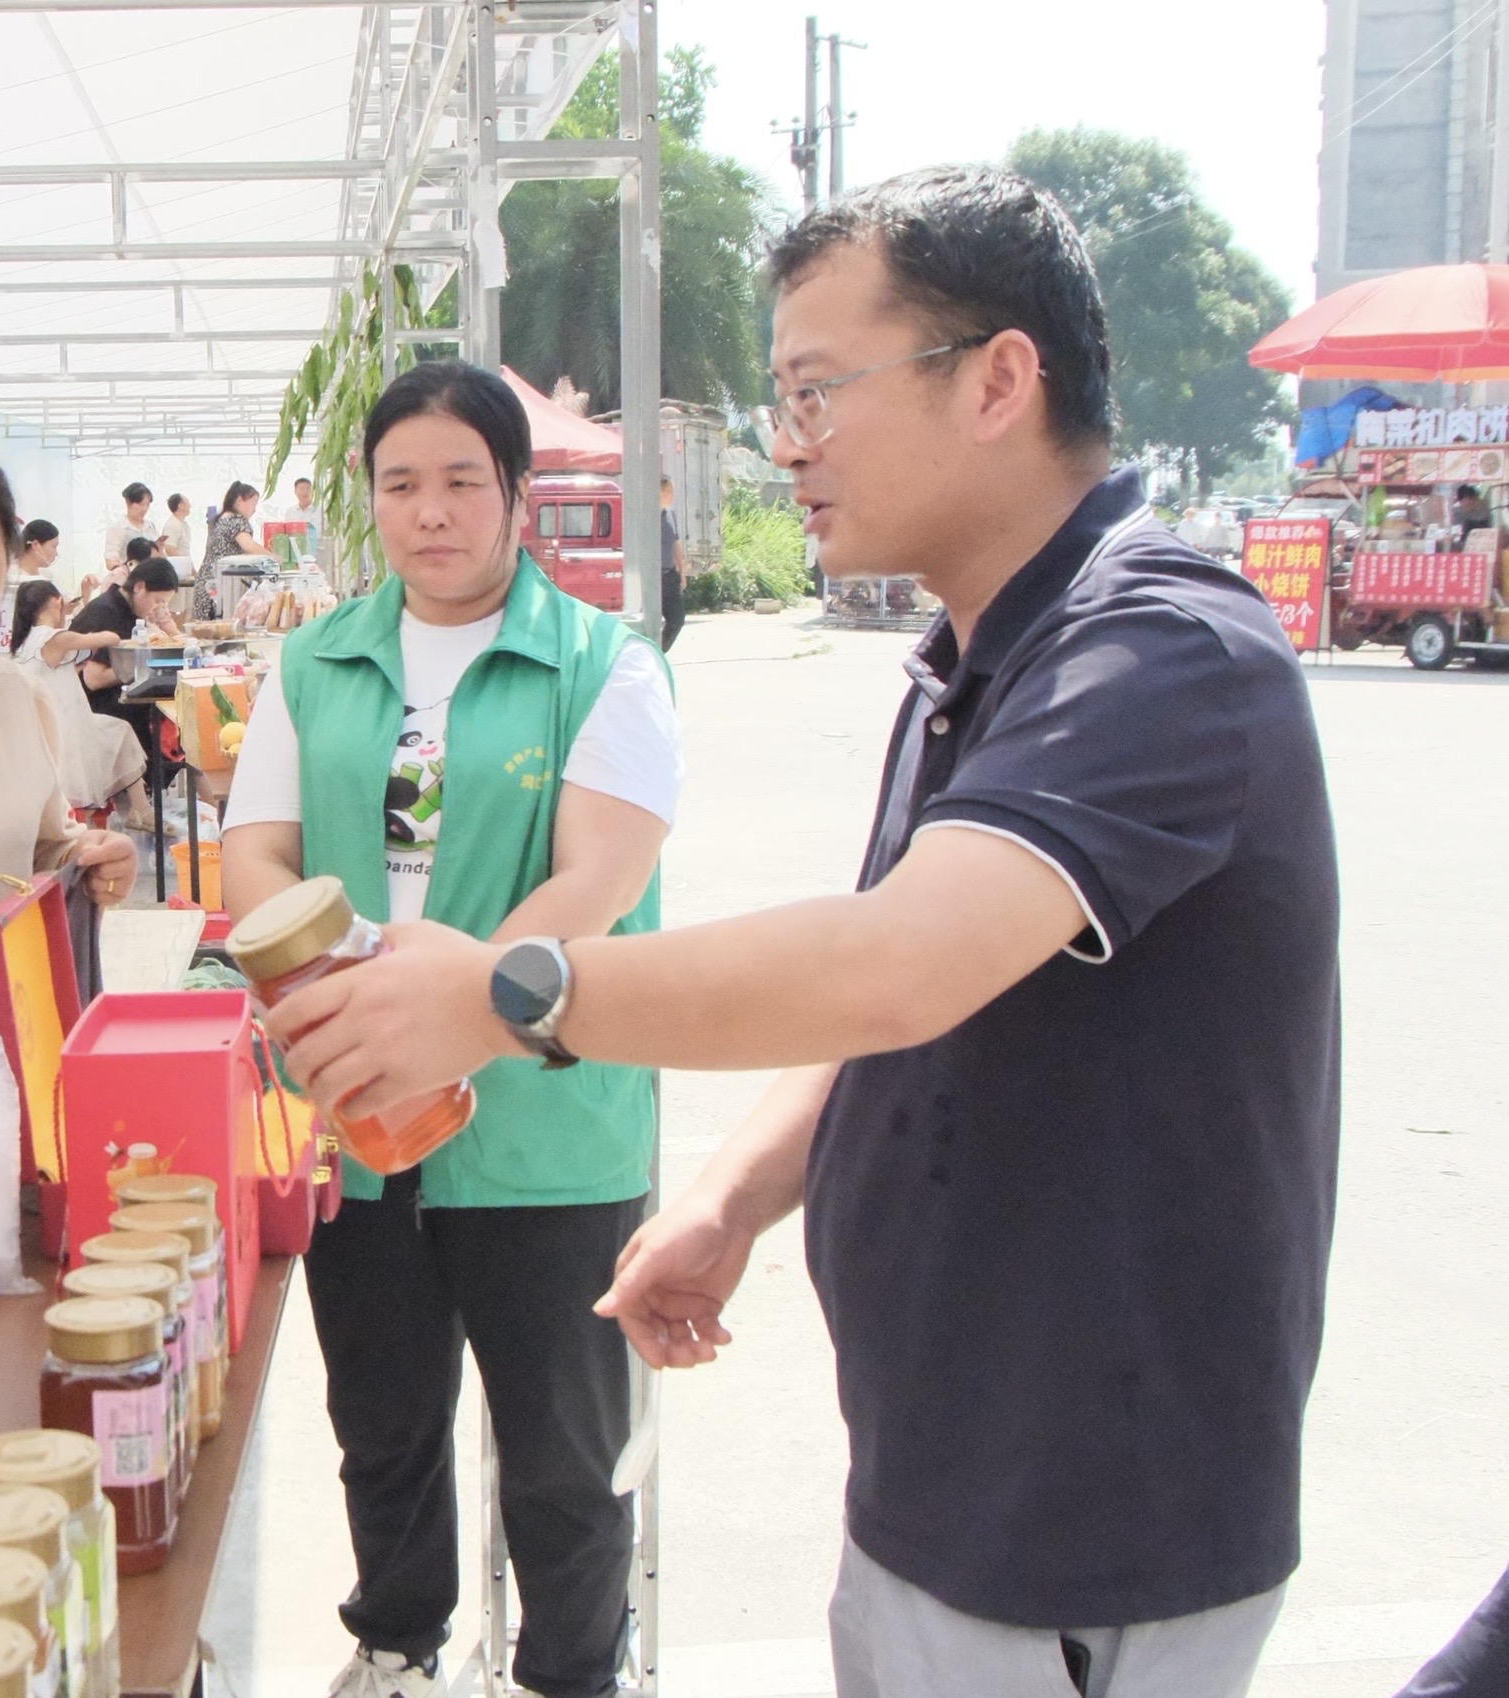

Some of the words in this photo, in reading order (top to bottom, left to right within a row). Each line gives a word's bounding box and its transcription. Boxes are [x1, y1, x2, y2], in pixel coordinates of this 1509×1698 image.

[1247, 543, 1322, 569] 爆汁鲜肉
[1254, 573, 1310, 597] 小烧饼
